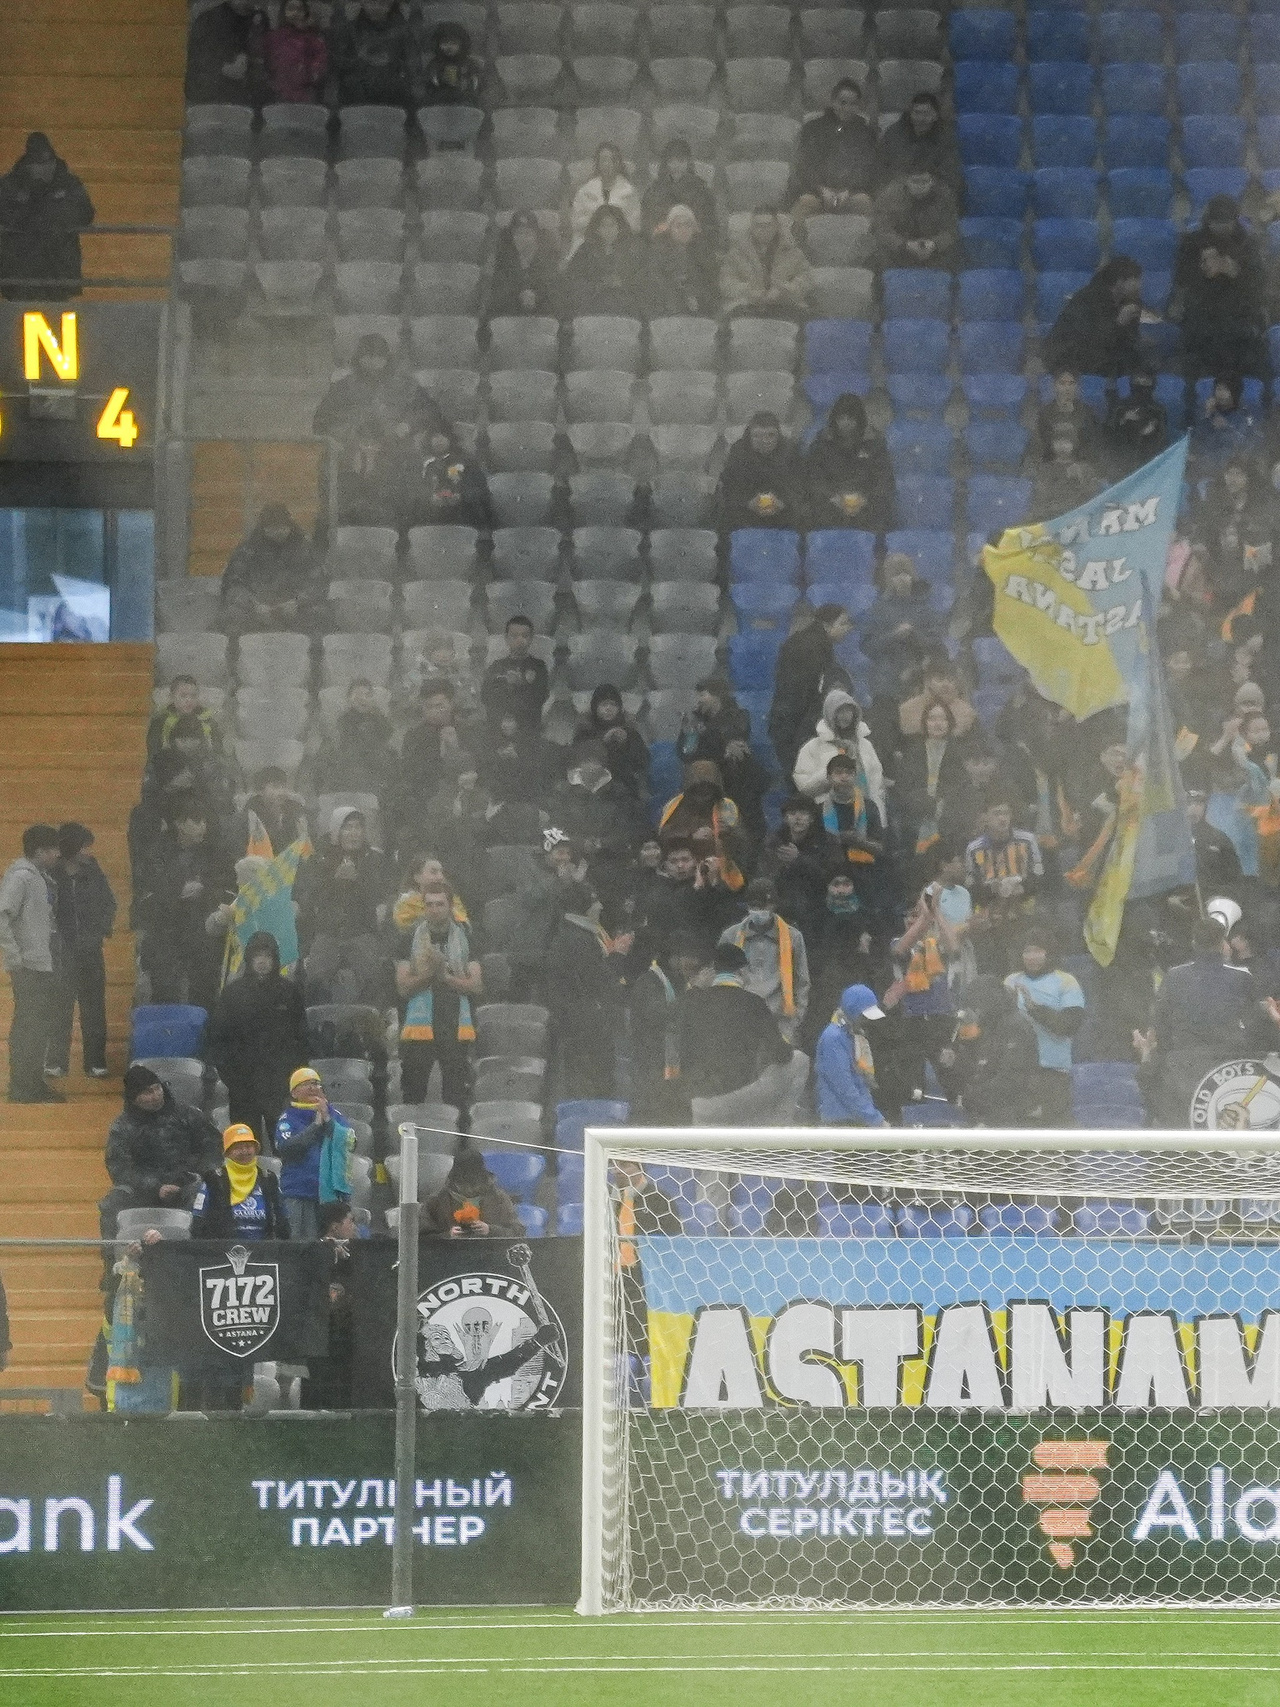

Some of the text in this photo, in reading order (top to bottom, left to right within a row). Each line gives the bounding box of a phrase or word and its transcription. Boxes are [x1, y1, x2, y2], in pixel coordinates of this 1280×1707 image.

[23, 311, 78, 380] N
[97, 387, 138, 447] 4
[1212, 1062, 1256, 1086] BOYS
[205, 1274, 275, 1309] 7172
[417, 1278, 531, 1319] NORTH
[212, 1307, 271, 1326] CREW
[216, 1329, 258, 1338] ASTANA
[716, 1471, 947, 1504] ТИТУЛДЫҚ
[740, 1508, 933, 1537] СЕРІКТЕС
